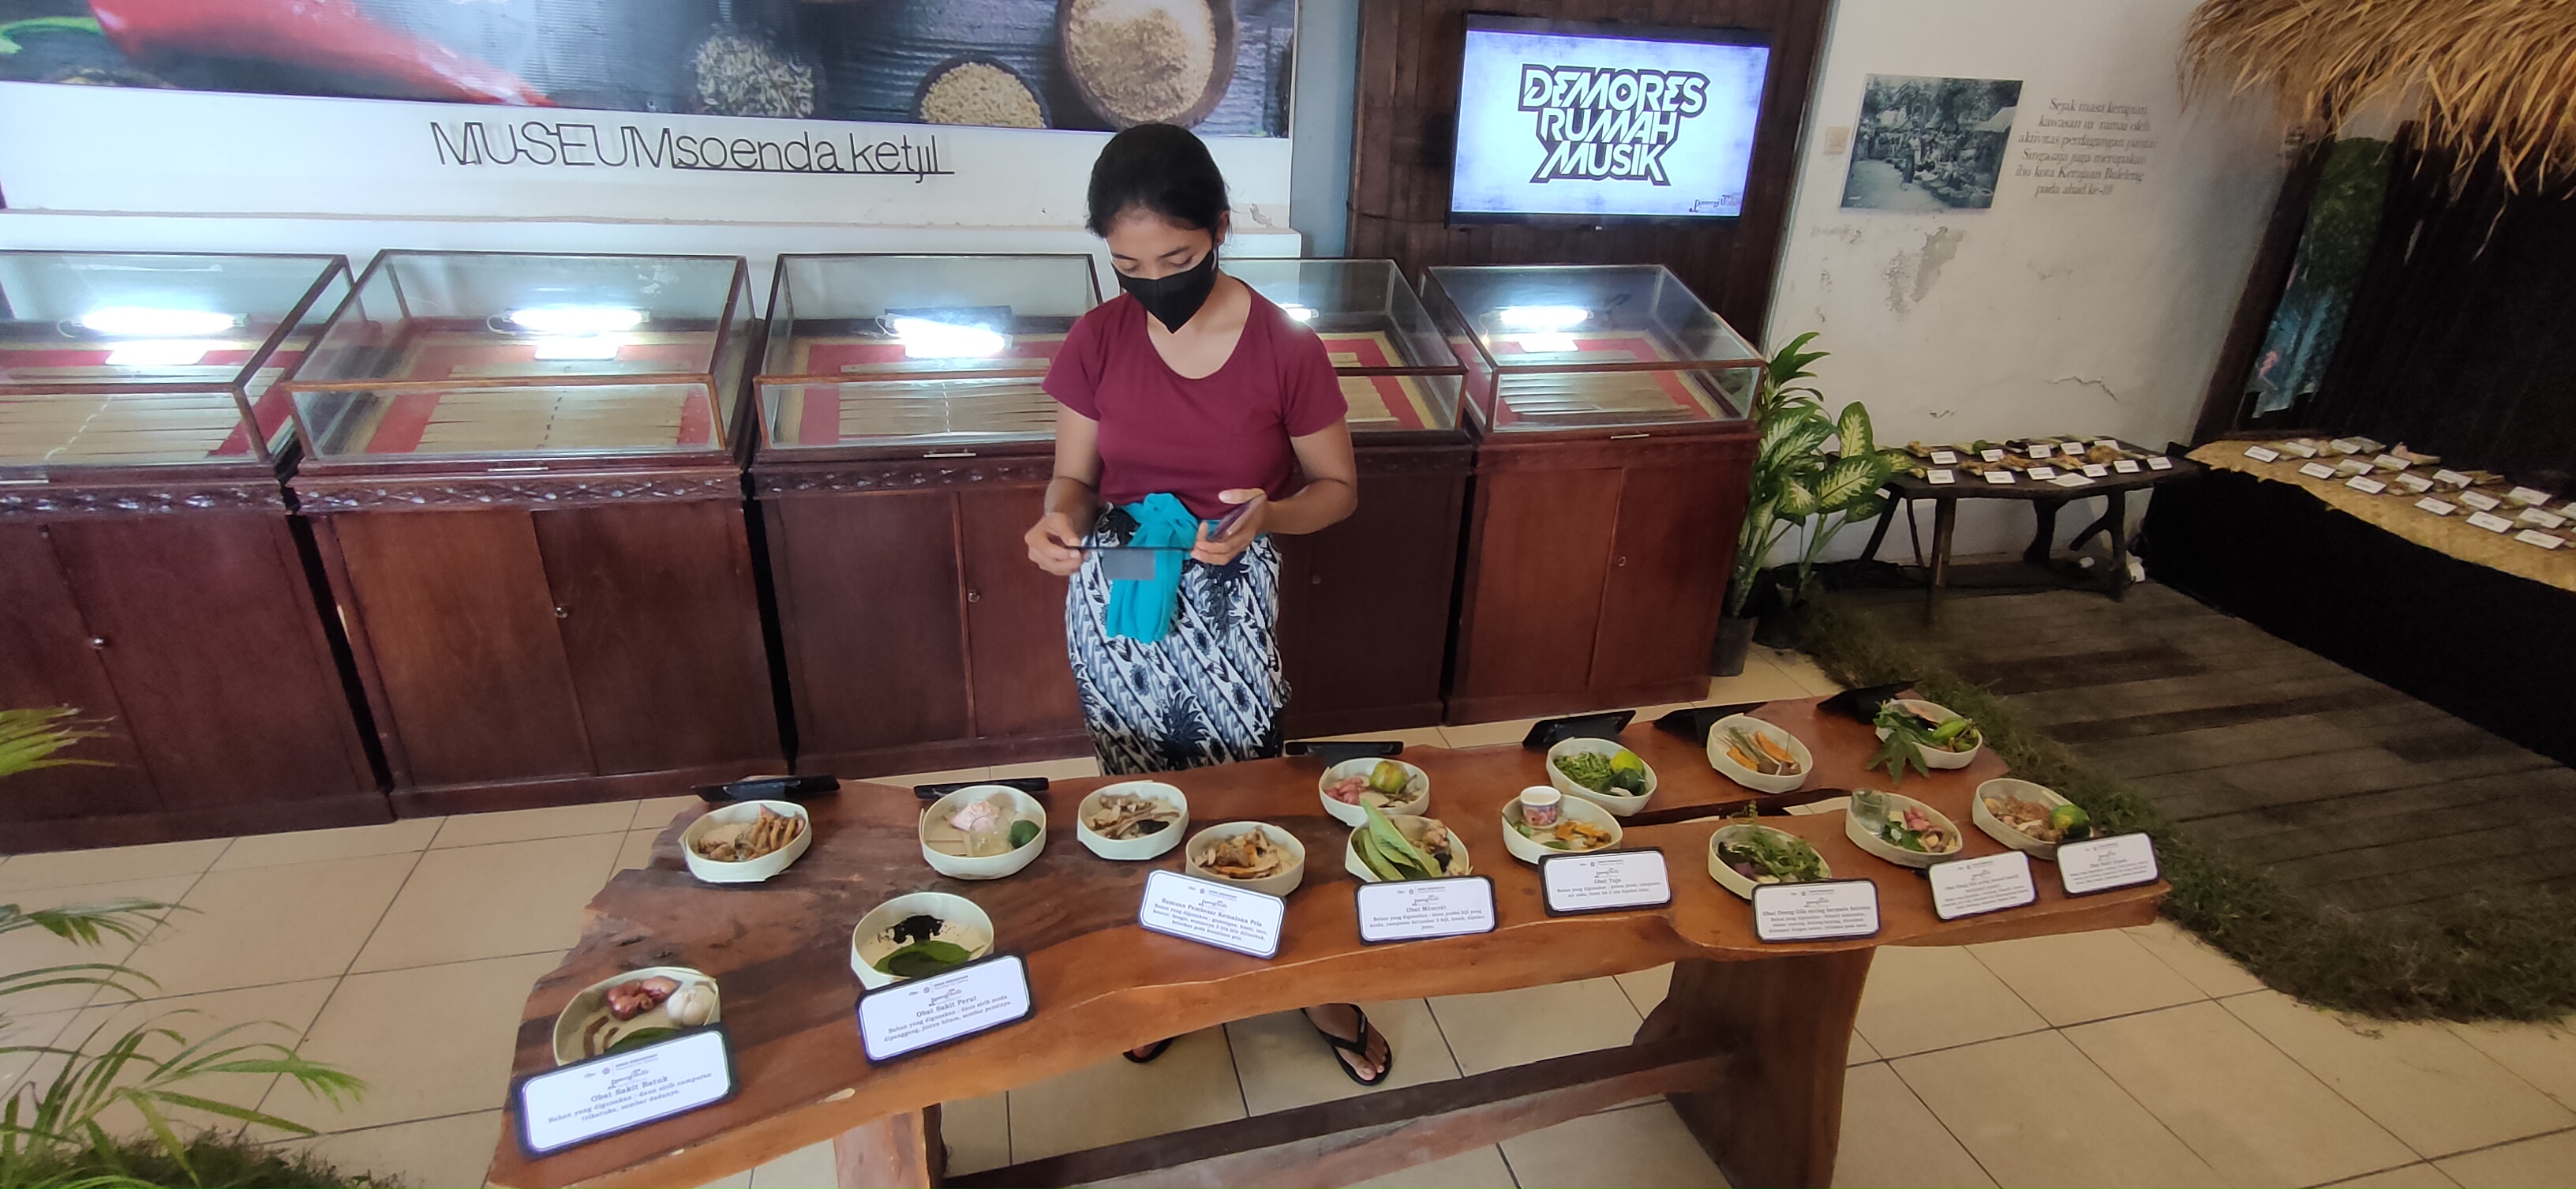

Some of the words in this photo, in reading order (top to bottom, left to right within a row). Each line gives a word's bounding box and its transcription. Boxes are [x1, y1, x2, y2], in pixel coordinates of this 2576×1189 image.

[1522, 69, 1706, 114] DEMORES
[2050, 97, 2075, 114] Sejak
[1540, 108, 1678, 144] RUMAH
[2039, 115, 2080, 127] kawasan
[2099, 121, 2128, 131] ramai
[2130, 122, 2151, 132] oleh
[2018, 132, 2059, 144] aktivitas
[2061, 133, 2124, 148] perdagangan
[1538, 141, 1666, 181] MUSIK
[2021, 148, 2068, 165] Singaraja
[2069, 153, 2091, 166] juga
[2093, 155, 2147, 167] merupakan
[2015, 164, 2031, 177] ibu
[2034, 167, 2055, 178] kota
[2057, 168, 2102, 182] Kerajaan
[2105, 168, 2145, 182] Buleleng
[2035, 184, 2060, 198] pada
[2062, 184, 2086, 195] abad
[1161, 898, 1185, 908] Ramuan
[1187, 904, 1216, 915] Pembesar
[1218, 911, 1248, 923] Kemaluan
[888, 1023, 907, 1033] Bahan
[908, 1018, 923, 1028] yang
[924, 1009, 956, 1023] digunakan
[960, 1003, 975, 1012] daun
[976, 999, 990, 1007] sirih
[915, 1007, 933, 1018] Obat
[935, 1001, 954, 1011] Sakit
[957, 995, 977, 1005] Perut
[883, 1026, 920, 1043] dipanggang,
[922, 1021, 939, 1032] jinten
[941, 1015, 960, 1025] hitam,
[548, 1111, 571, 1123] Bahan
[574, 1105, 592, 1116] yang
[593, 1093, 631, 1110] digunakan
[638, 1086, 657, 1097] daun
[658, 1082, 675, 1091] sirih
[676, 1071, 712, 1087] campuran
[590, 1090, 612, 1102] Obat
[615, 1083, 638, 1096] Sakit
[641, 1075, 668, 1088] Batuk
